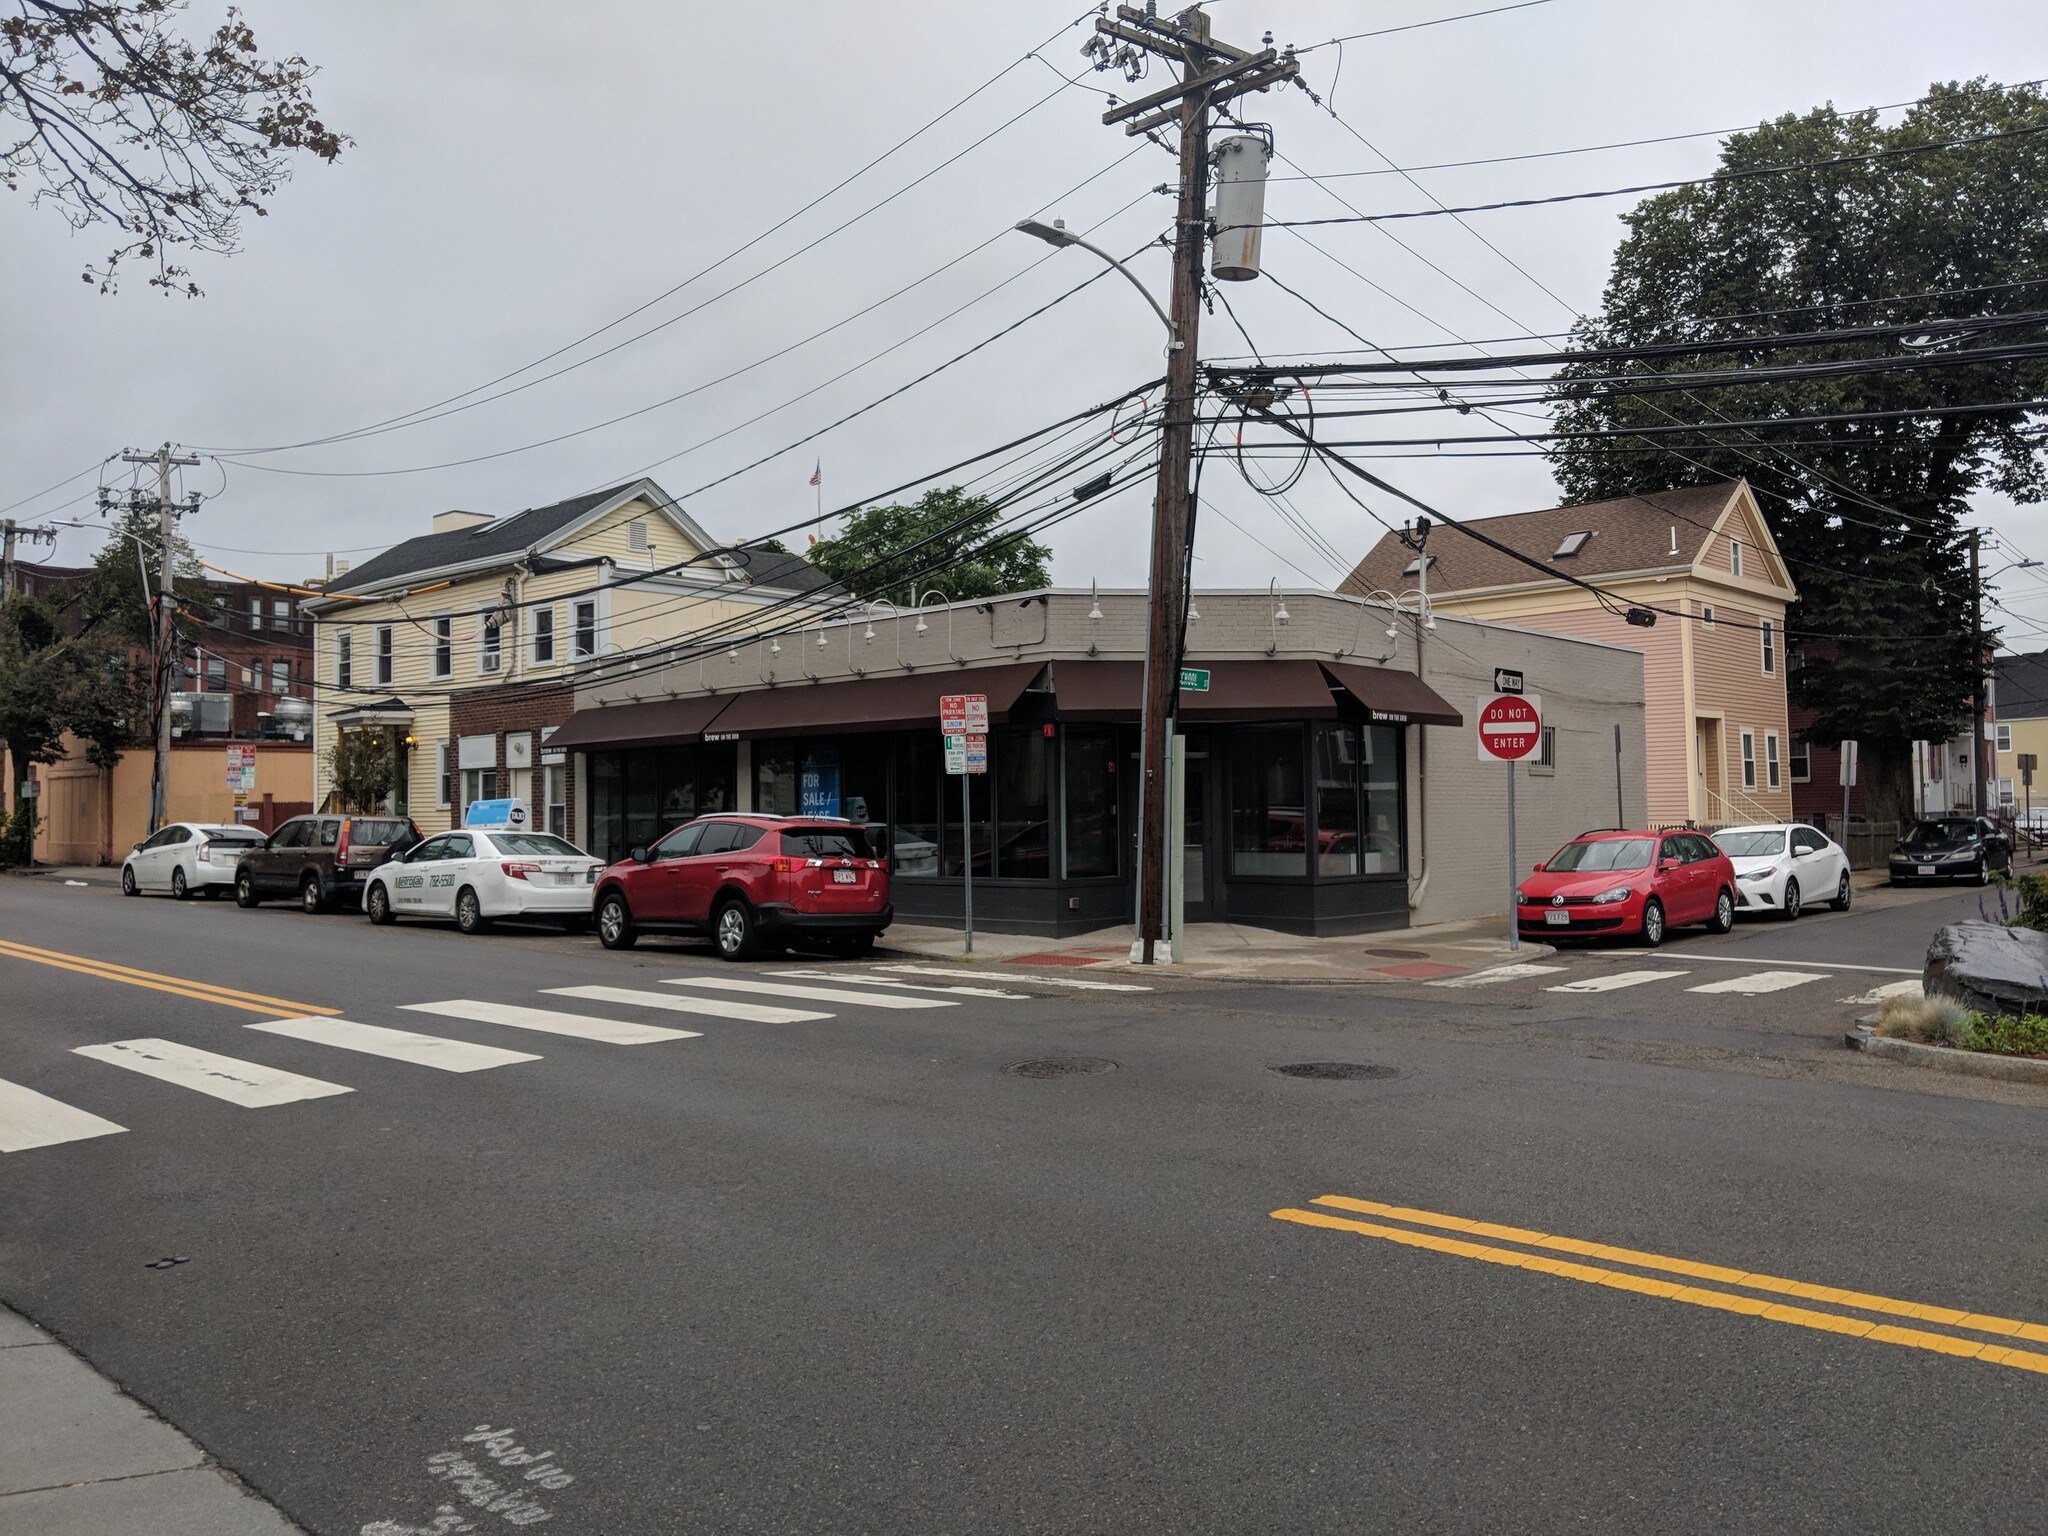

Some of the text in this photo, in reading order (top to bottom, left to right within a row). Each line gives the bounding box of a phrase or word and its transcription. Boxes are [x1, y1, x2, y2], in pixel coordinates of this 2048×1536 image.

[1503, 676, 1520, 688] ONE WAY
[1372, 710, 1388, 720] brew
[1490, 708, 1527, 720] DO NOT
[1494, 738, 1525, 749] ENTER
[802, 774, 820, 788] FOR
[802, 792, 825, 806] SALE
[511, 812, 525, 820] TAXI
